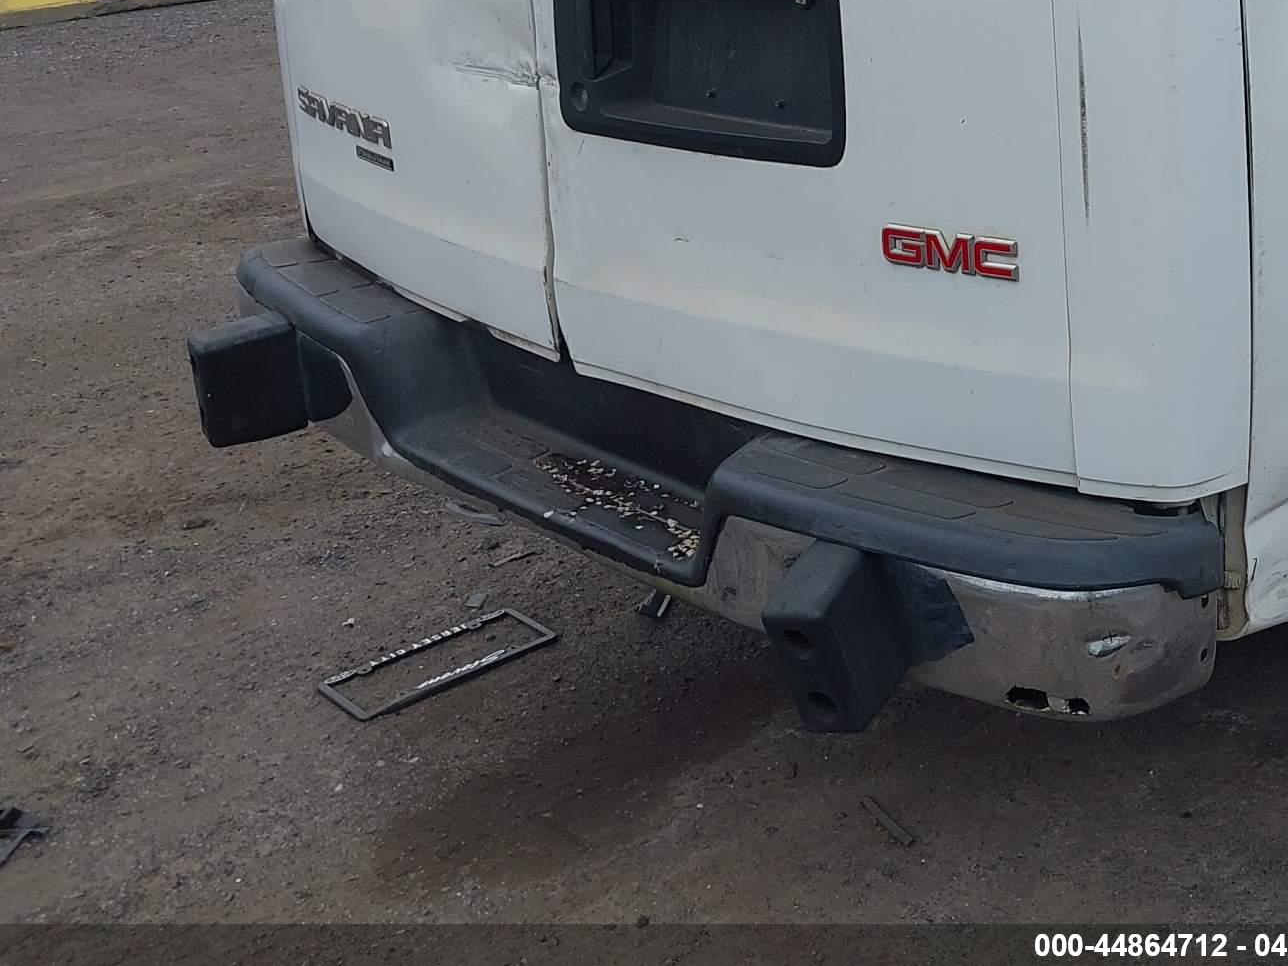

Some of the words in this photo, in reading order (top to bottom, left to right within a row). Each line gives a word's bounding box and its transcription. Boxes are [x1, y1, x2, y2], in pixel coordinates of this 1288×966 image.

[297, 85, 392, 150] SAVANA
[882, 222, 1020, 282] GMC
[369, 648, 406, 667] CITY
[411, 623, 468, 650] JERSEY
